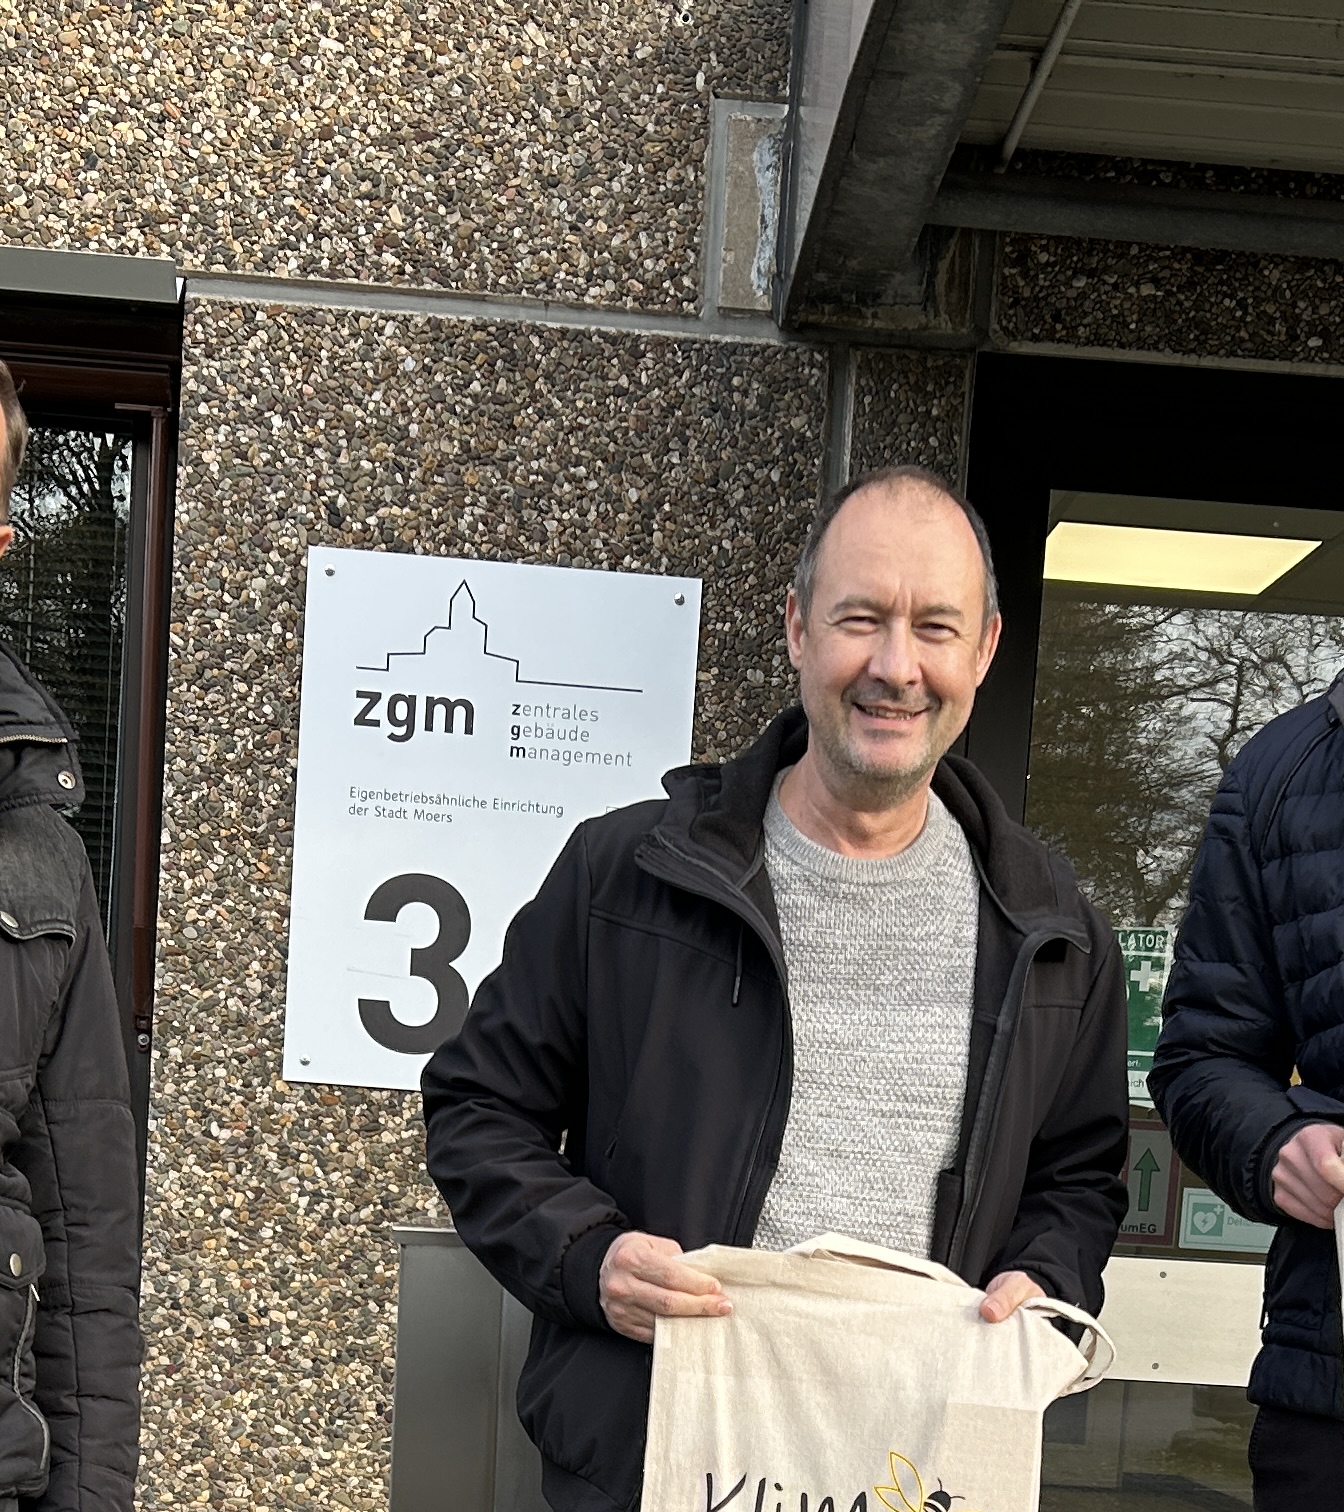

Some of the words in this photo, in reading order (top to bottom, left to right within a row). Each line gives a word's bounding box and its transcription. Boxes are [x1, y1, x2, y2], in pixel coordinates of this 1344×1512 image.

[353, 689, 475, 743] zgm
[511, 703, 600, 722] zentrales
[510, 721, 590, 742] gebäude
[509, 745, 632, 767] management
[349, 786, 488, 809] Eigenbetriebsähnliche
[493, 798, 565, 818] Einrichtung
[348, 803, 369, 816] der
[374, 805, 408, 820] Stadt
[413, 808, 453, 823] Moers
